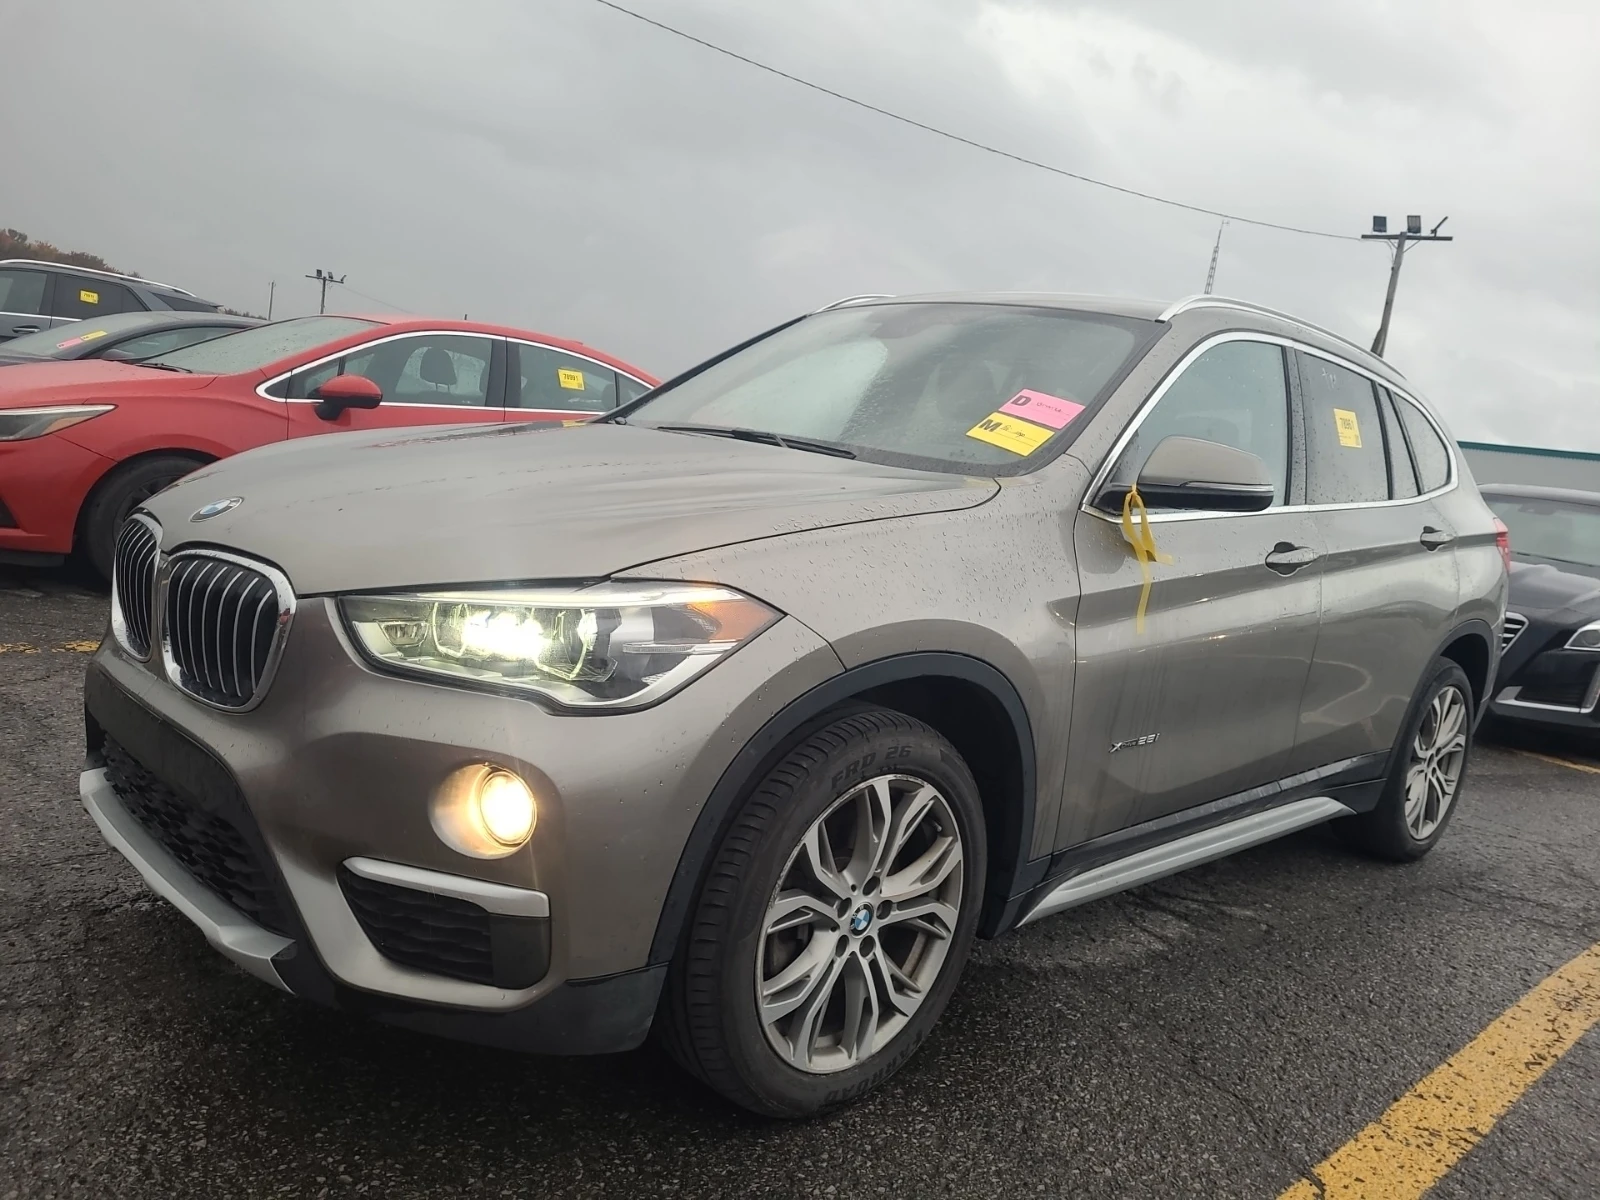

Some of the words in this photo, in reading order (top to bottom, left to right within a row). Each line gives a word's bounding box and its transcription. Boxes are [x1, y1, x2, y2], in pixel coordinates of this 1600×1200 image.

[1011, 395, 1032, 406] D
[978, 419, 1003, 432] M
[831, 752, 877, 791] FRD
[885, 745, 914, 761] 26
